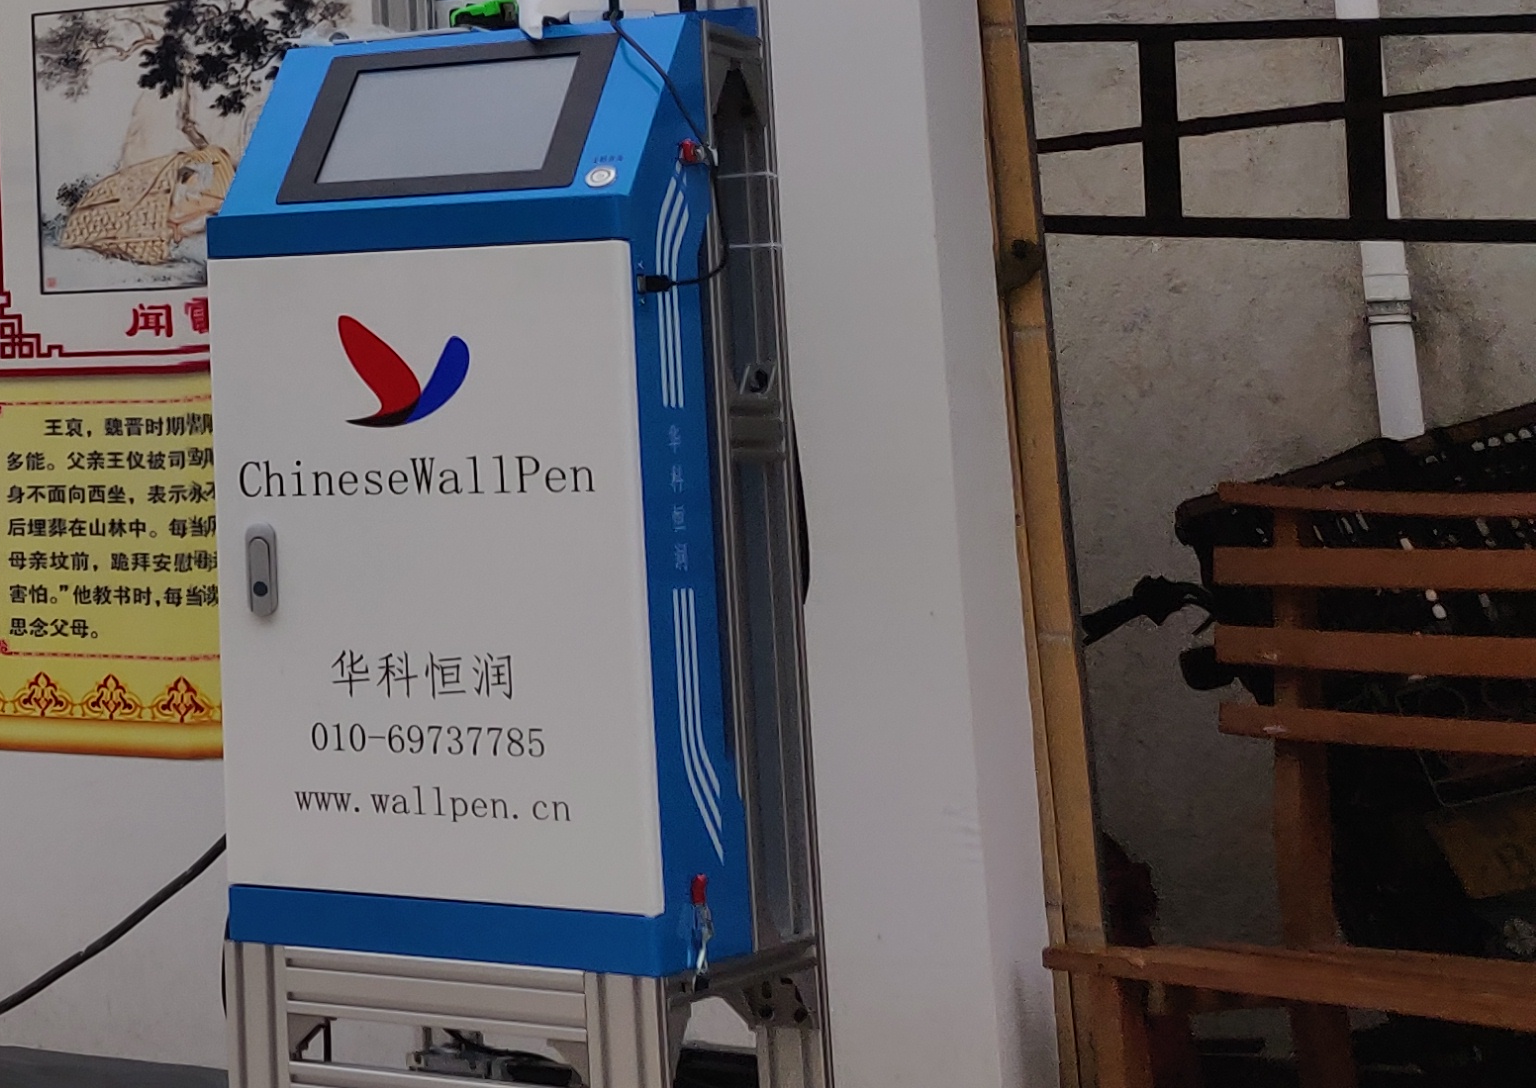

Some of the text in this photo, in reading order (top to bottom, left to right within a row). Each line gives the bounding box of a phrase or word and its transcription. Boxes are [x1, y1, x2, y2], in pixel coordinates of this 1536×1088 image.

[239, 455, 596, 498] ChineseWallPen
[10, 617, 100, 640] 思念父母。
[331, 650, 514, 700] 华科恒润
[311, 722, 546, 758] 010-69737785
[294, 785, 571, 823] www.wallpen.cn
